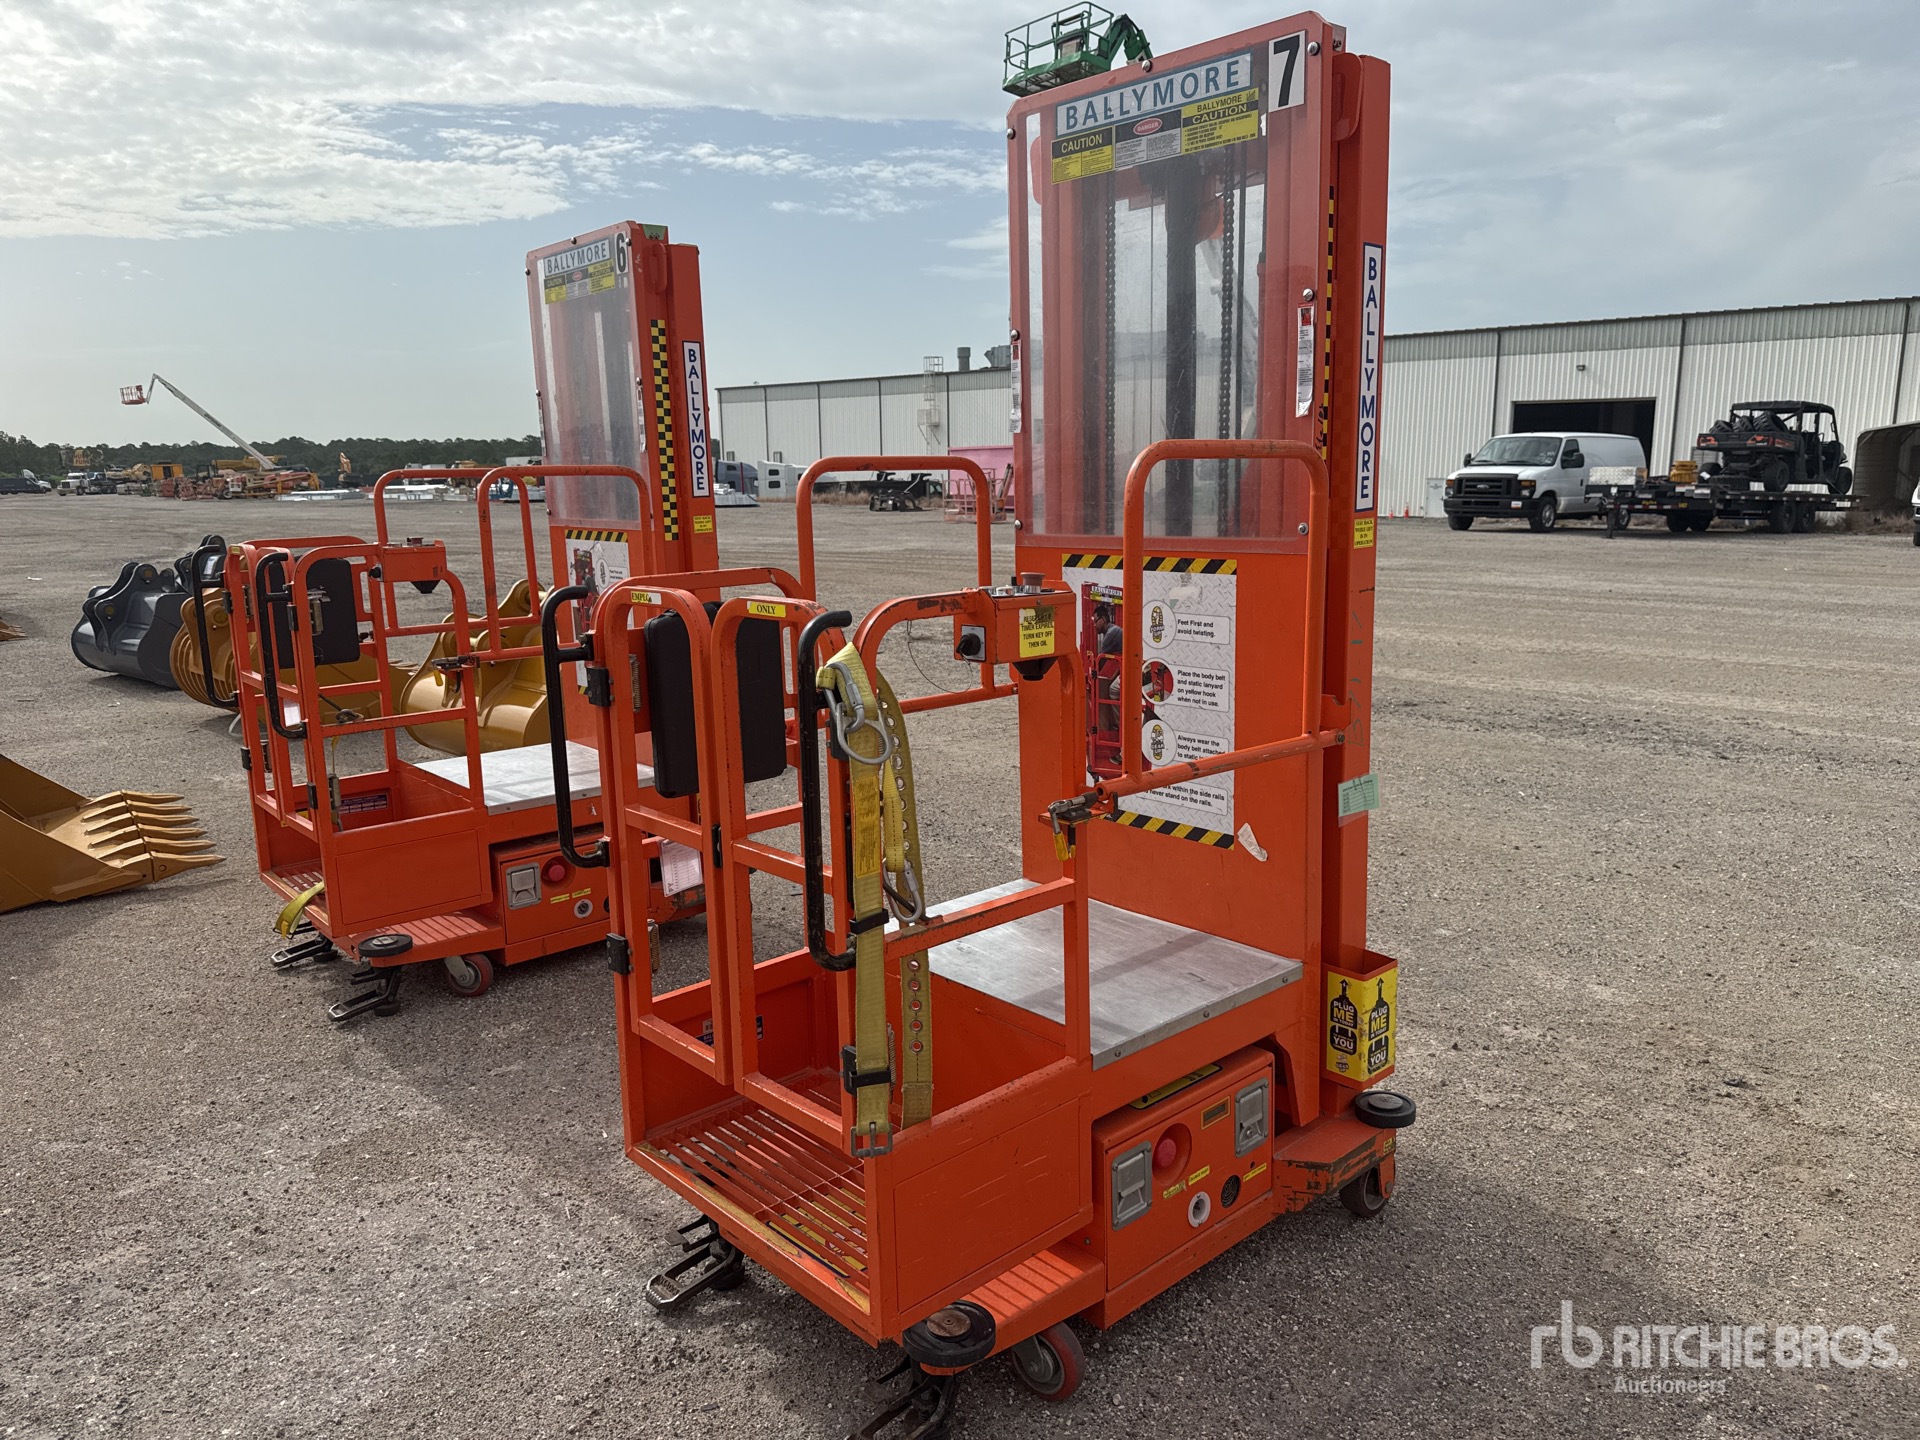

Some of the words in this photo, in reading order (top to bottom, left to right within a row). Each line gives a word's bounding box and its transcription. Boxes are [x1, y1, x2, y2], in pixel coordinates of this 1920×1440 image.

[1273, 34, 1300, 108] 7
[1066, 59, 1239, 130] BALLYMORE
[1197, 94, 1243, 112] BALLYMORE
[1192, 103, 1247, 124] CAUTION
[1137, 121, 1159, 132] DANGER
[1061, 133, 1103, 153] CAUTION
[547, 242, 607, 274] BALLYMORE
[616, 232, 627, 273] 6
[1360, 256, 1377, 499] BALLYMORE
[688, 348, 705, 490] BALLYMORE
[756, 604, 777, 615] ONLY
[1189, 619, 1203, 627] First
[1035, 631, 1044, 639] KEY
[1192, 629, 1215, 638] twisting.
[1028, 640, 1040, 648] THEN
[1177, 669, 1191, 677] Place
[1192, 670, 1200, 678] the
[1201, 671, 1214, 680] body
[1215, 673, 1226, 681] belt
[1188, 679, 1202, 687] static
[1203, 681, 1223, 690] lanyard
[1185, 687, 1202, 695] yellow
[1202, 689, 1216, 698] hook
[1177, 734, 1196, 743] Always
[1177, 743, 1190, 752] body
[1165, 792, 1180, 800] stand
[1172, 784, 1188, 793] within
[1189, 788, 1199, 796] the
[1199, 790, 1212, 798] side
[1212, 793, 1225, 801] rails
[1333, 1000, 1354, 1012] PLUG
[1371, 1005, 1388, 1020] PLUG
[1333, 1007, 1354, 1023] ME
[1371, 1013, 1387, 1033] ME
[1333, 1036, 1354, 1050] YOU
[1370, 1050, 1387, 1065] YOU
